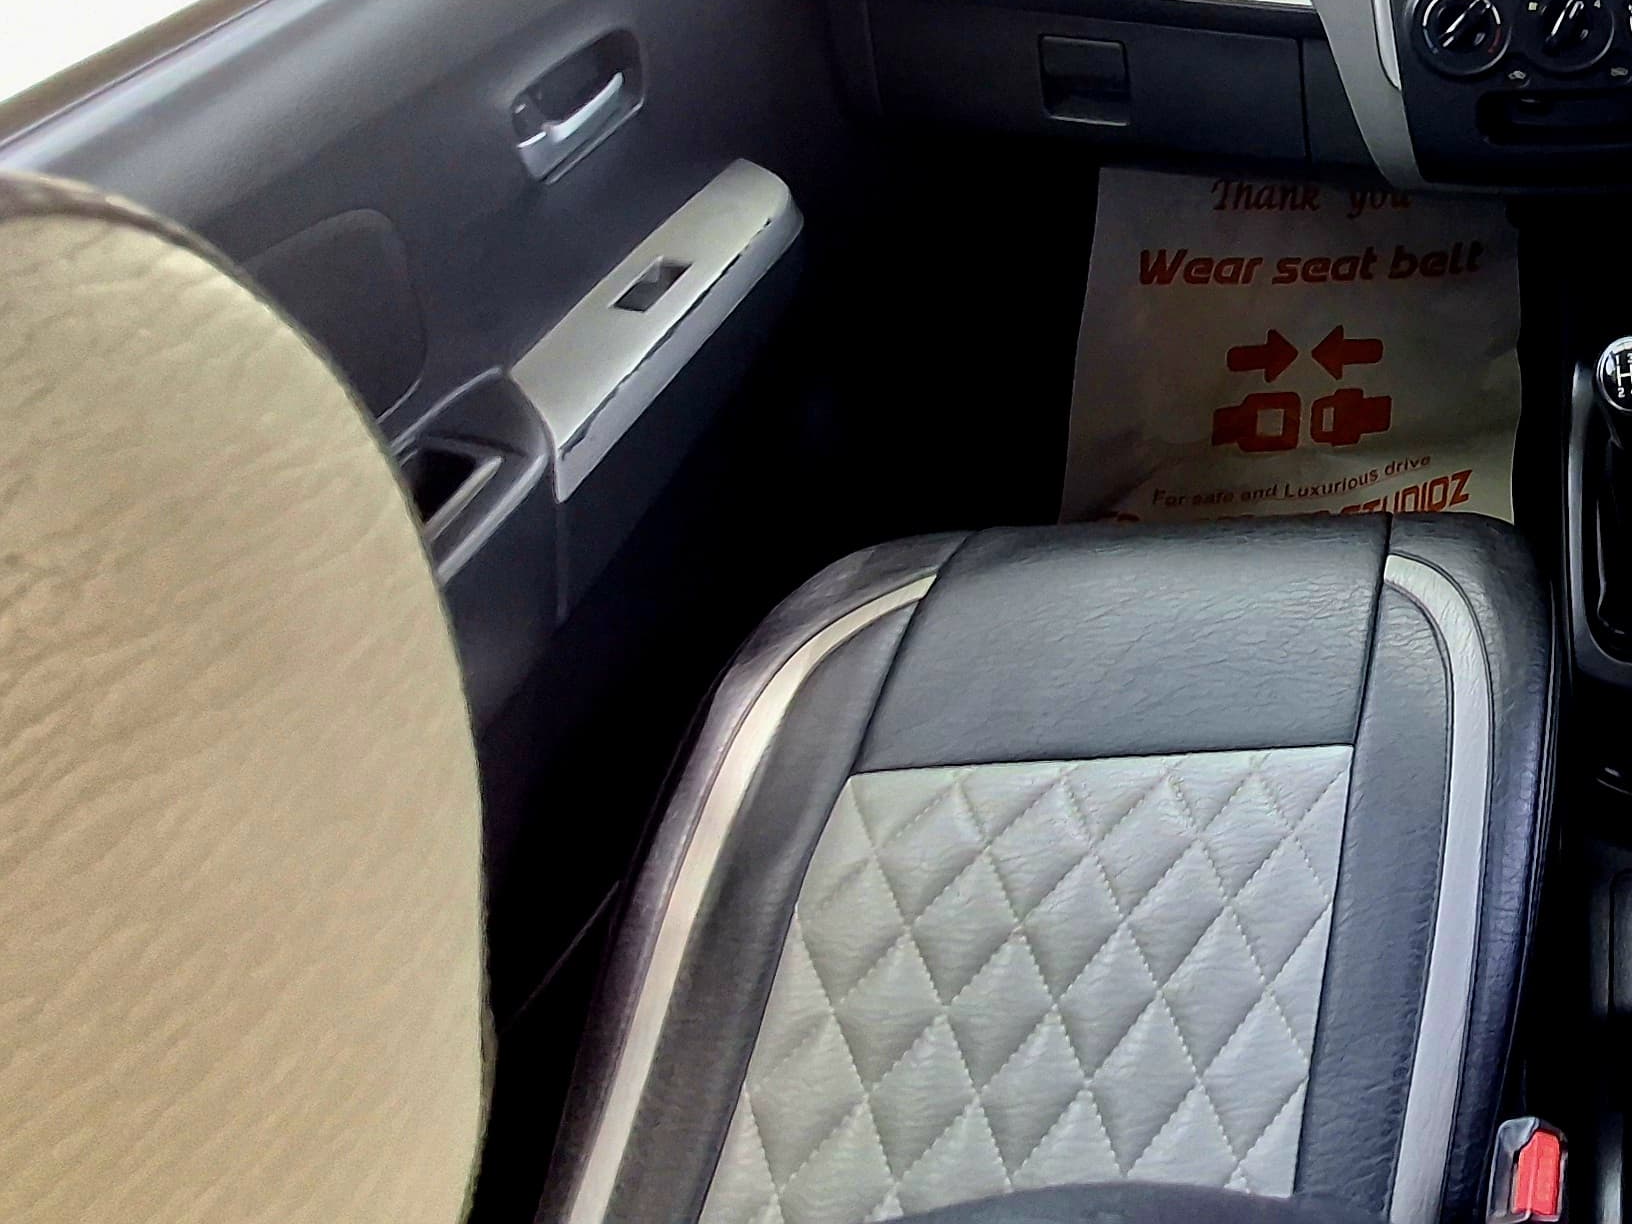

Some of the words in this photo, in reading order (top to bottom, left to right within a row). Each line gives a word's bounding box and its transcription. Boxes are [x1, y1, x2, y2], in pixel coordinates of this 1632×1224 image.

[1593, 0, 1600, 8] 4
[1211, 179, 1320, 211] Thank
[1138, 248, 1263, 285] Wear
[1273, 246, 1378, 284] seat
[1388, 241, 1486, 279] belt
[1617, 387, 1625, 398] 2
[1152, 488, 1185, 506] For
[1192, 486, 1235, 506] safe
[1241, 484, 1278, 503] and
[1285, 468, 1378, 498] Luxurious
[1384, 455, 1431, 477] drive
